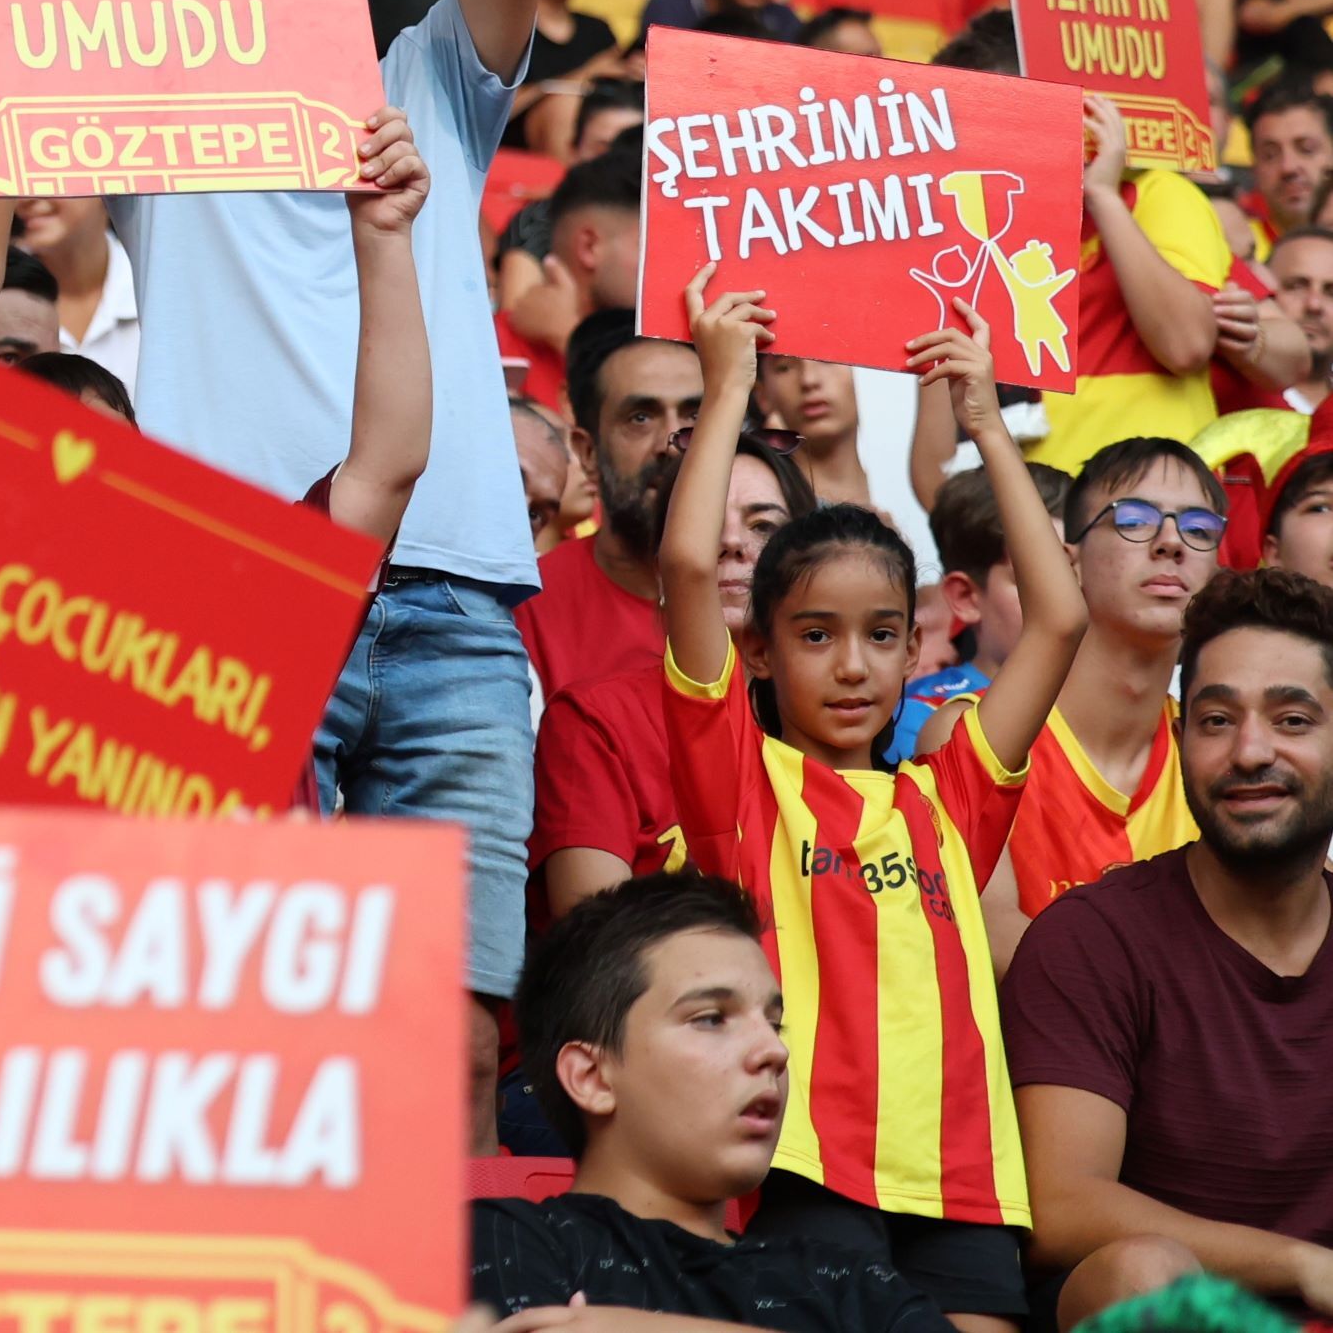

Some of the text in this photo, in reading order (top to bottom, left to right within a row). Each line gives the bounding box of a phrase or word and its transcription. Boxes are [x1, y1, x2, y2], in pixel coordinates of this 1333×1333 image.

[1059, 20, 1167, 80] UMUDU
[29, 116, 293, 169] GÖZTEPE
[647, 77, 957, 198] ŞEHRİMİN
[684, 173, 945, 262] TAKIMI
[38, 873, 395, 1015] SAYGI
